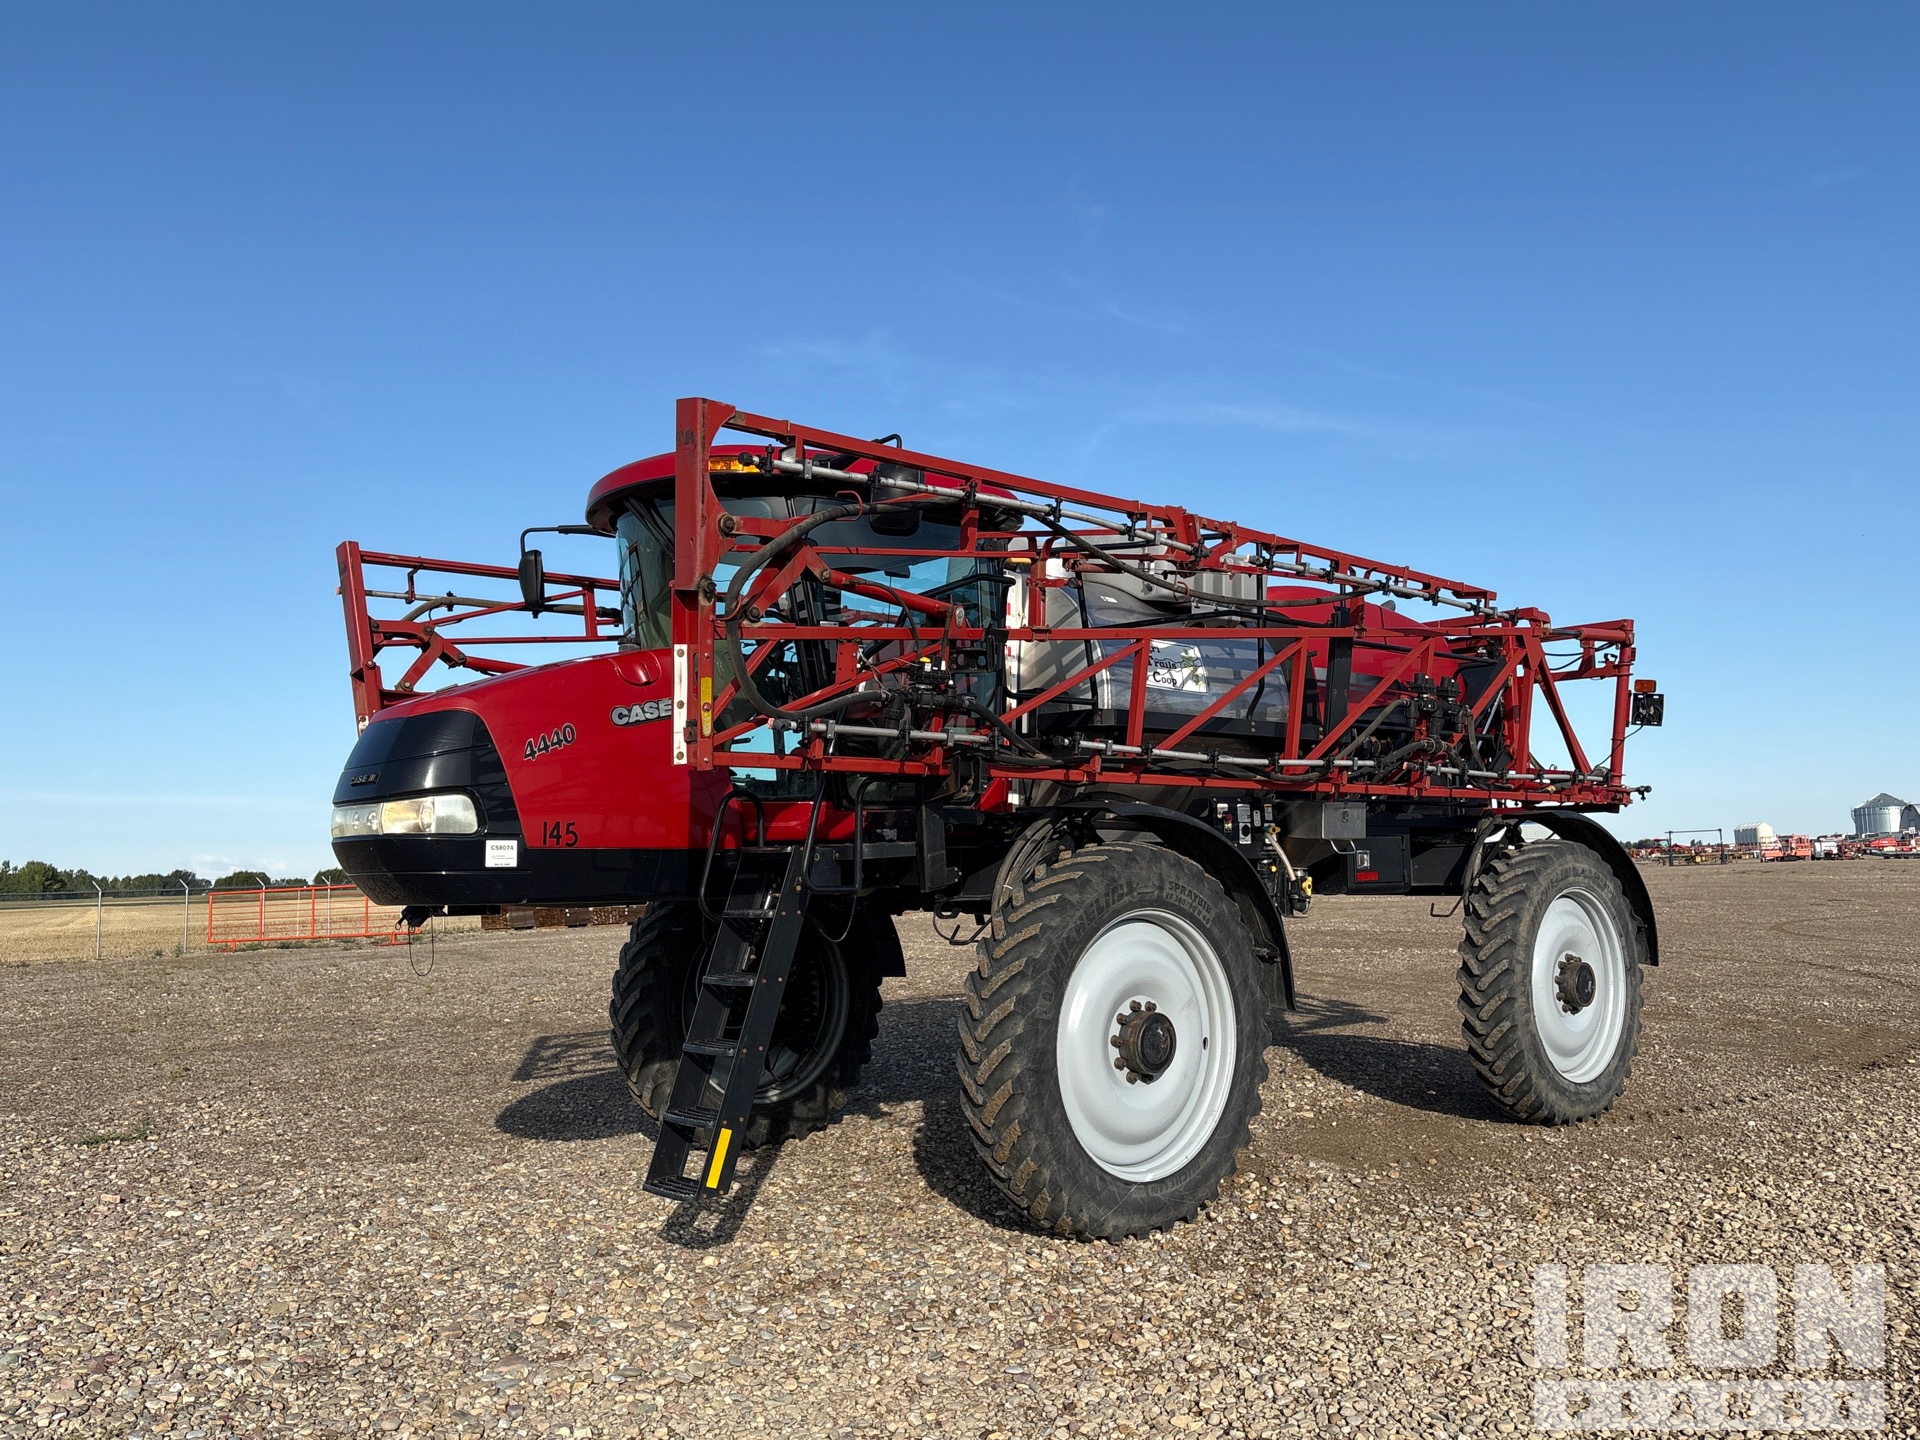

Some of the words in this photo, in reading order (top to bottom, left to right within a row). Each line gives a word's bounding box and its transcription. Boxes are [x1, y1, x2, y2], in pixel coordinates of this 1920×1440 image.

[611, 699, 672, 726] CASE
[523, 723, 576, 760] 4440
[542, 821, 578, 847] 145
[1168, 880, 1213, 914] SPRAYBIB
